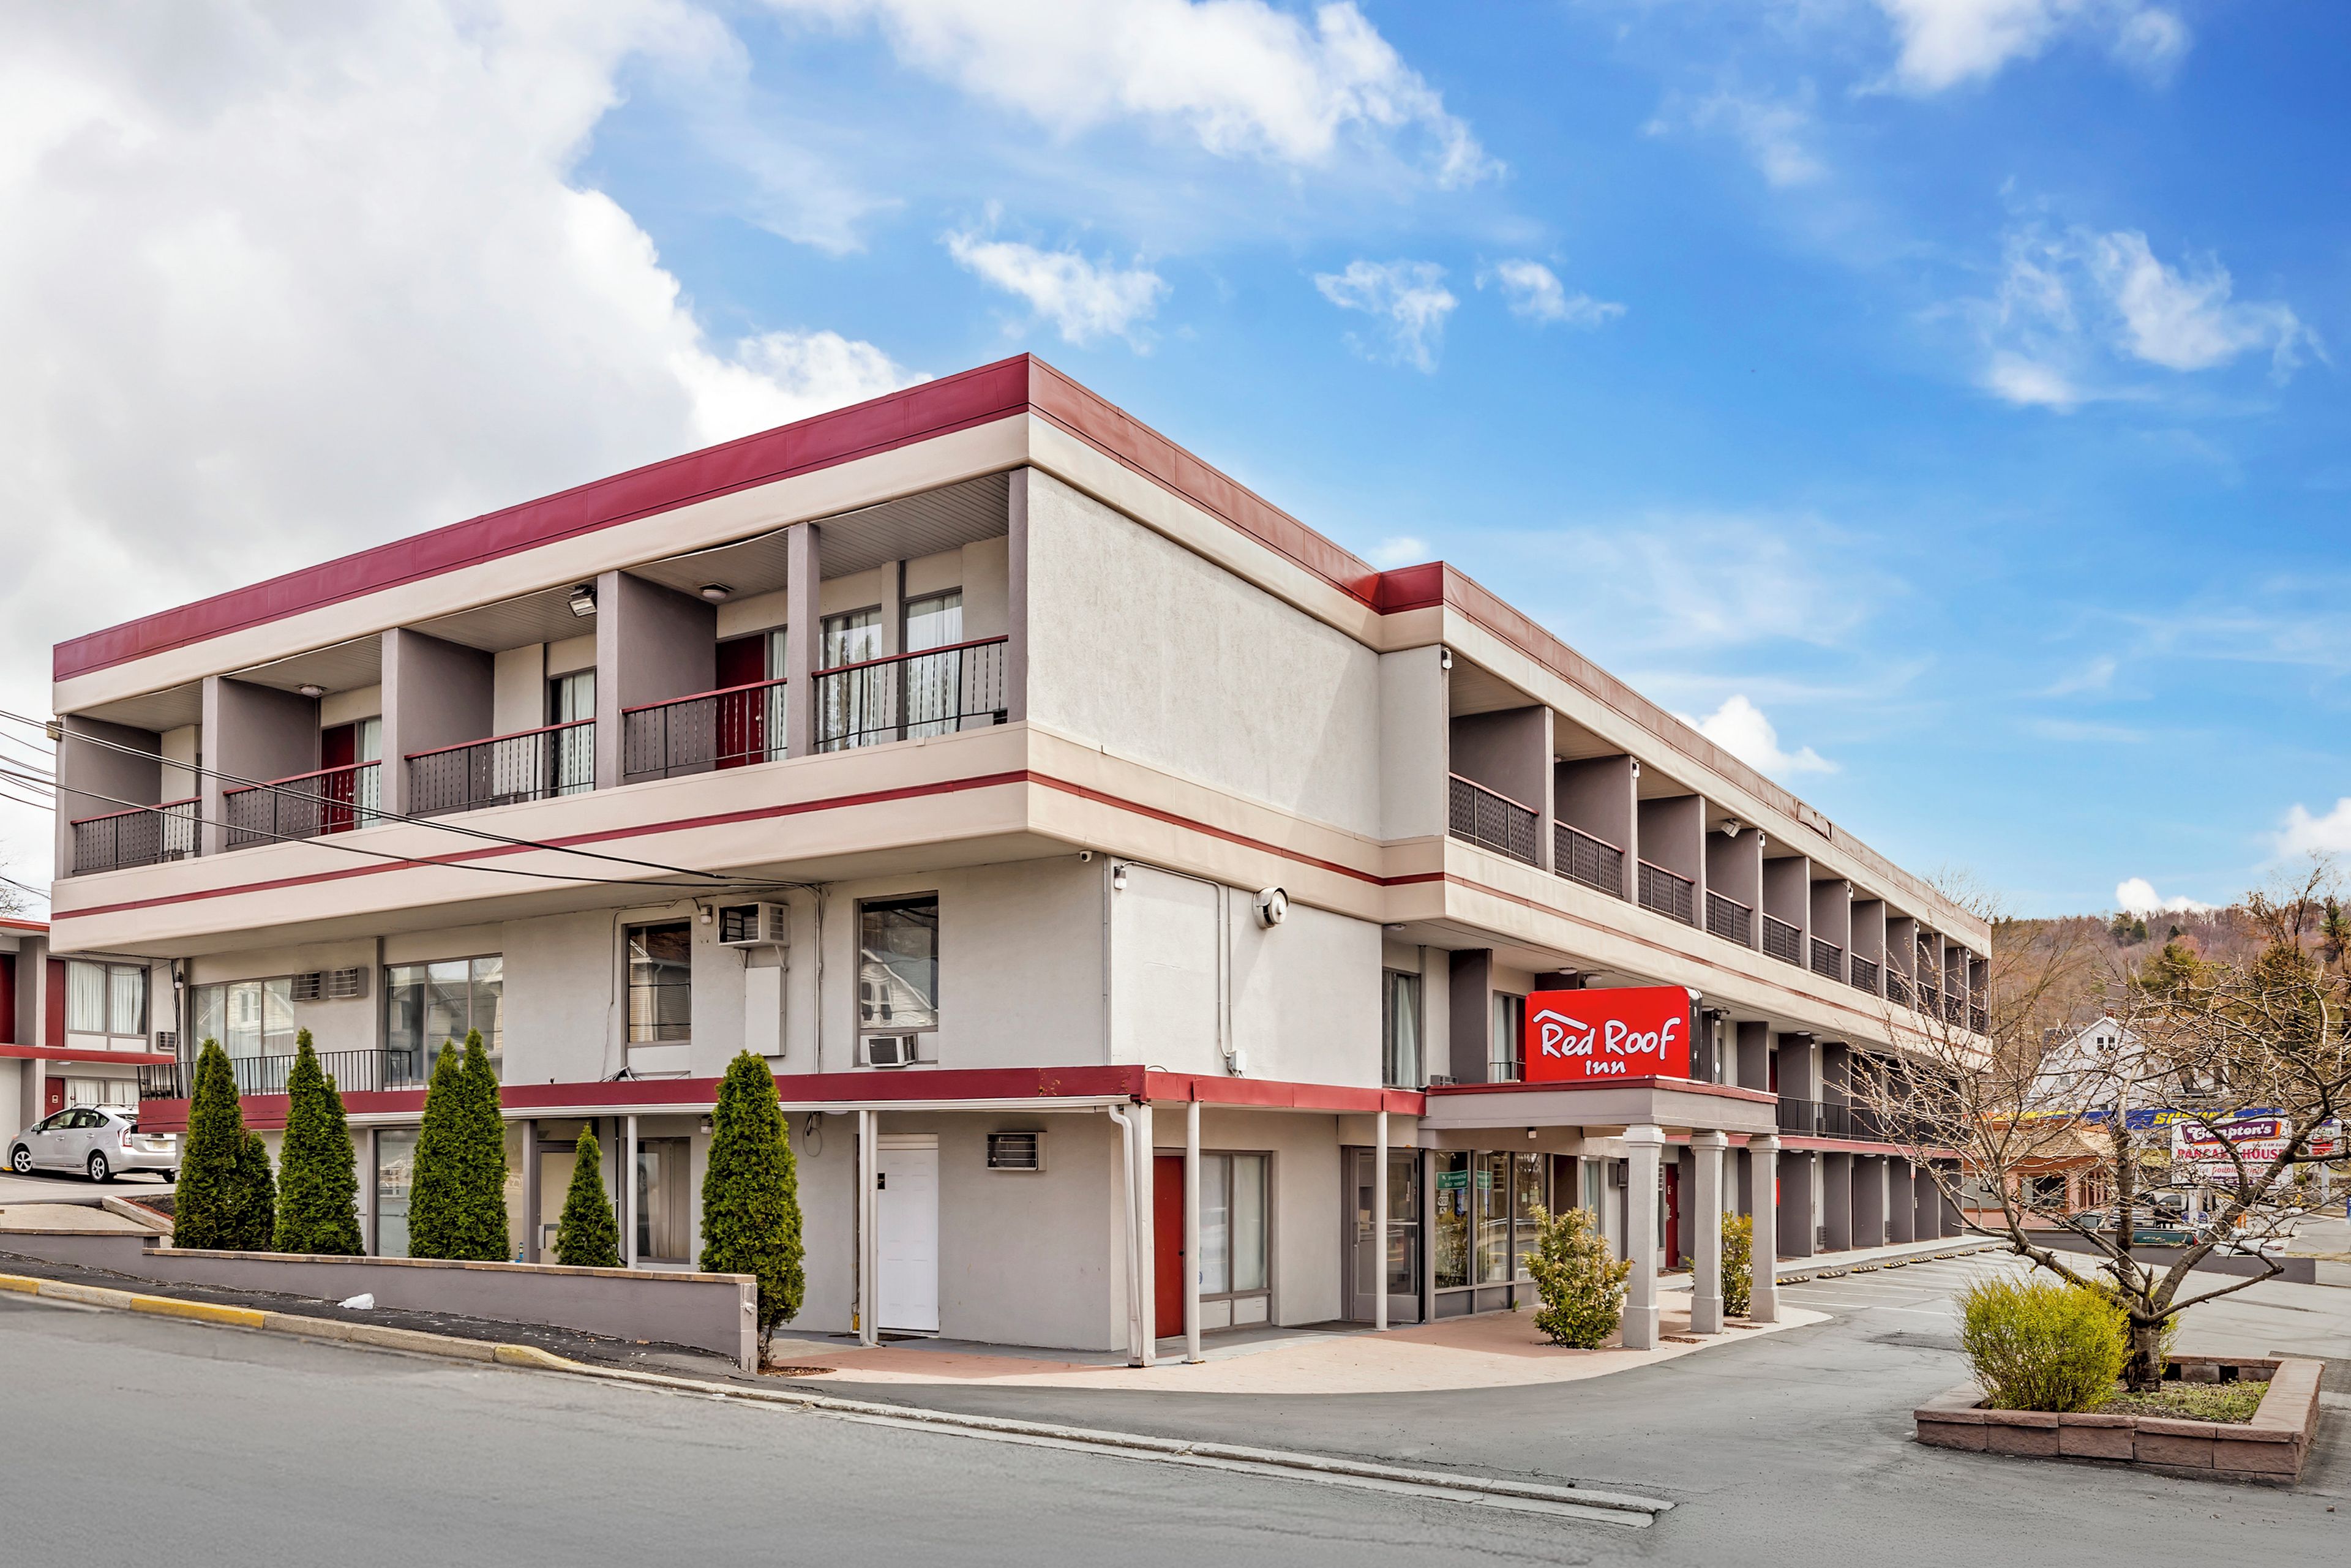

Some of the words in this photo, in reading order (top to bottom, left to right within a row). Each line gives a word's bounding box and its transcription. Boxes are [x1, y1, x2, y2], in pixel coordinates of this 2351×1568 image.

[1540, 1022, 1596, 1059] Red
[1604, 1016, 1681, 1060] Roof
[2177, 1149, 2233, 1160] PANCAK
[2242, 1149, 2285, 1160] HOUS
